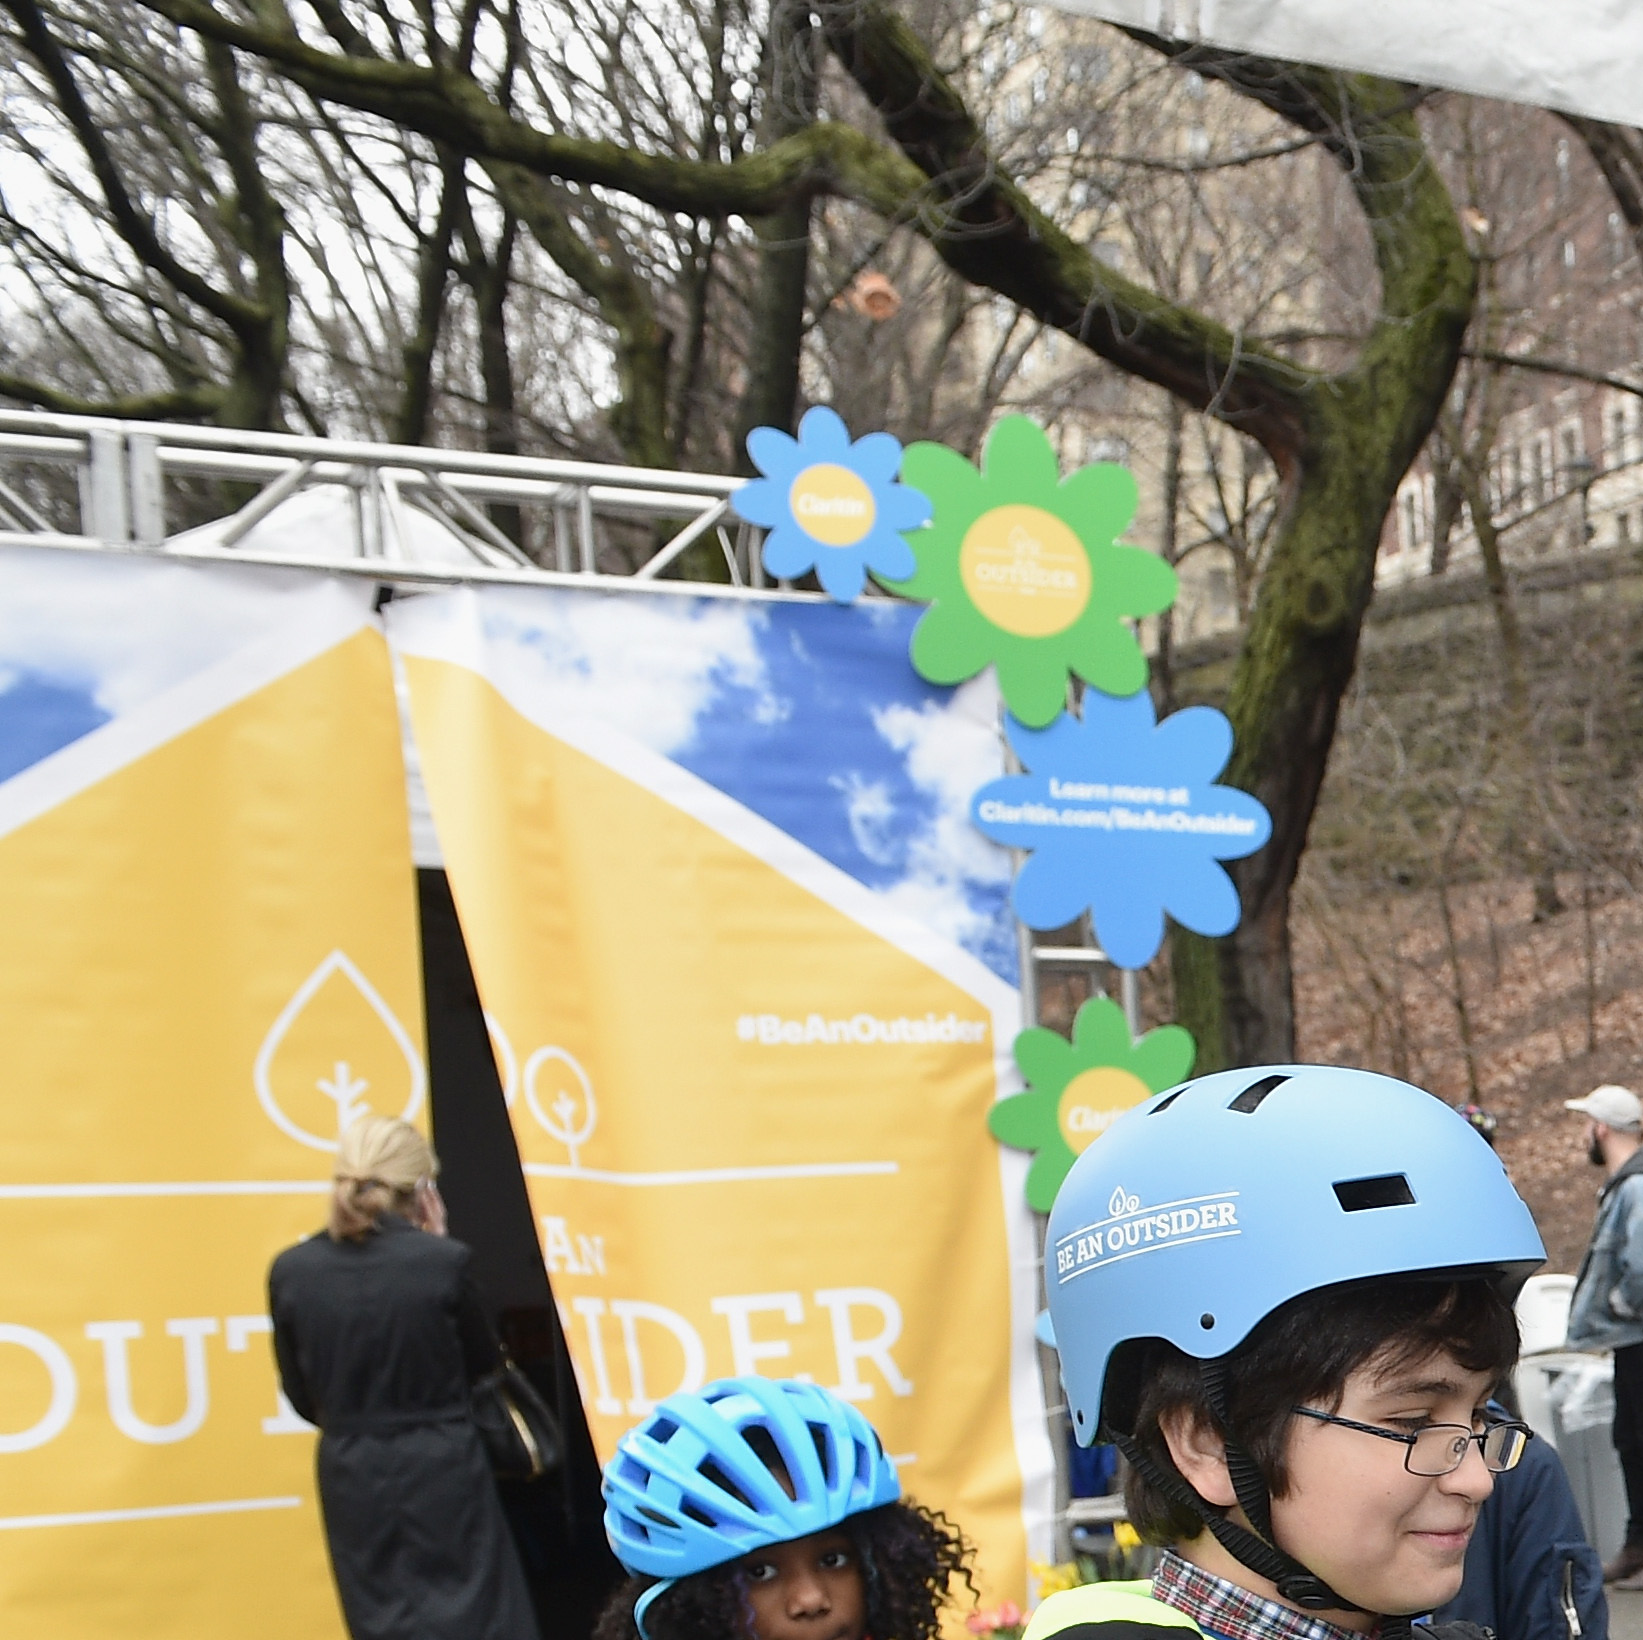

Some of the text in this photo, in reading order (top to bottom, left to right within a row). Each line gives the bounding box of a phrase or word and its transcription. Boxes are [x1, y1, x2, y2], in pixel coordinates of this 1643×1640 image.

[1050, 777, 1190, 806] Learn more at
[979, 800, 1256, 836] Claritin.com/BeAnOutsider
[737, 1013, 986, 1044] #BeAnOutsider
[1057, 1202, 1238, 1274] BE AN OUTSIDER
[556, 1286, 914, 1417] IDER
